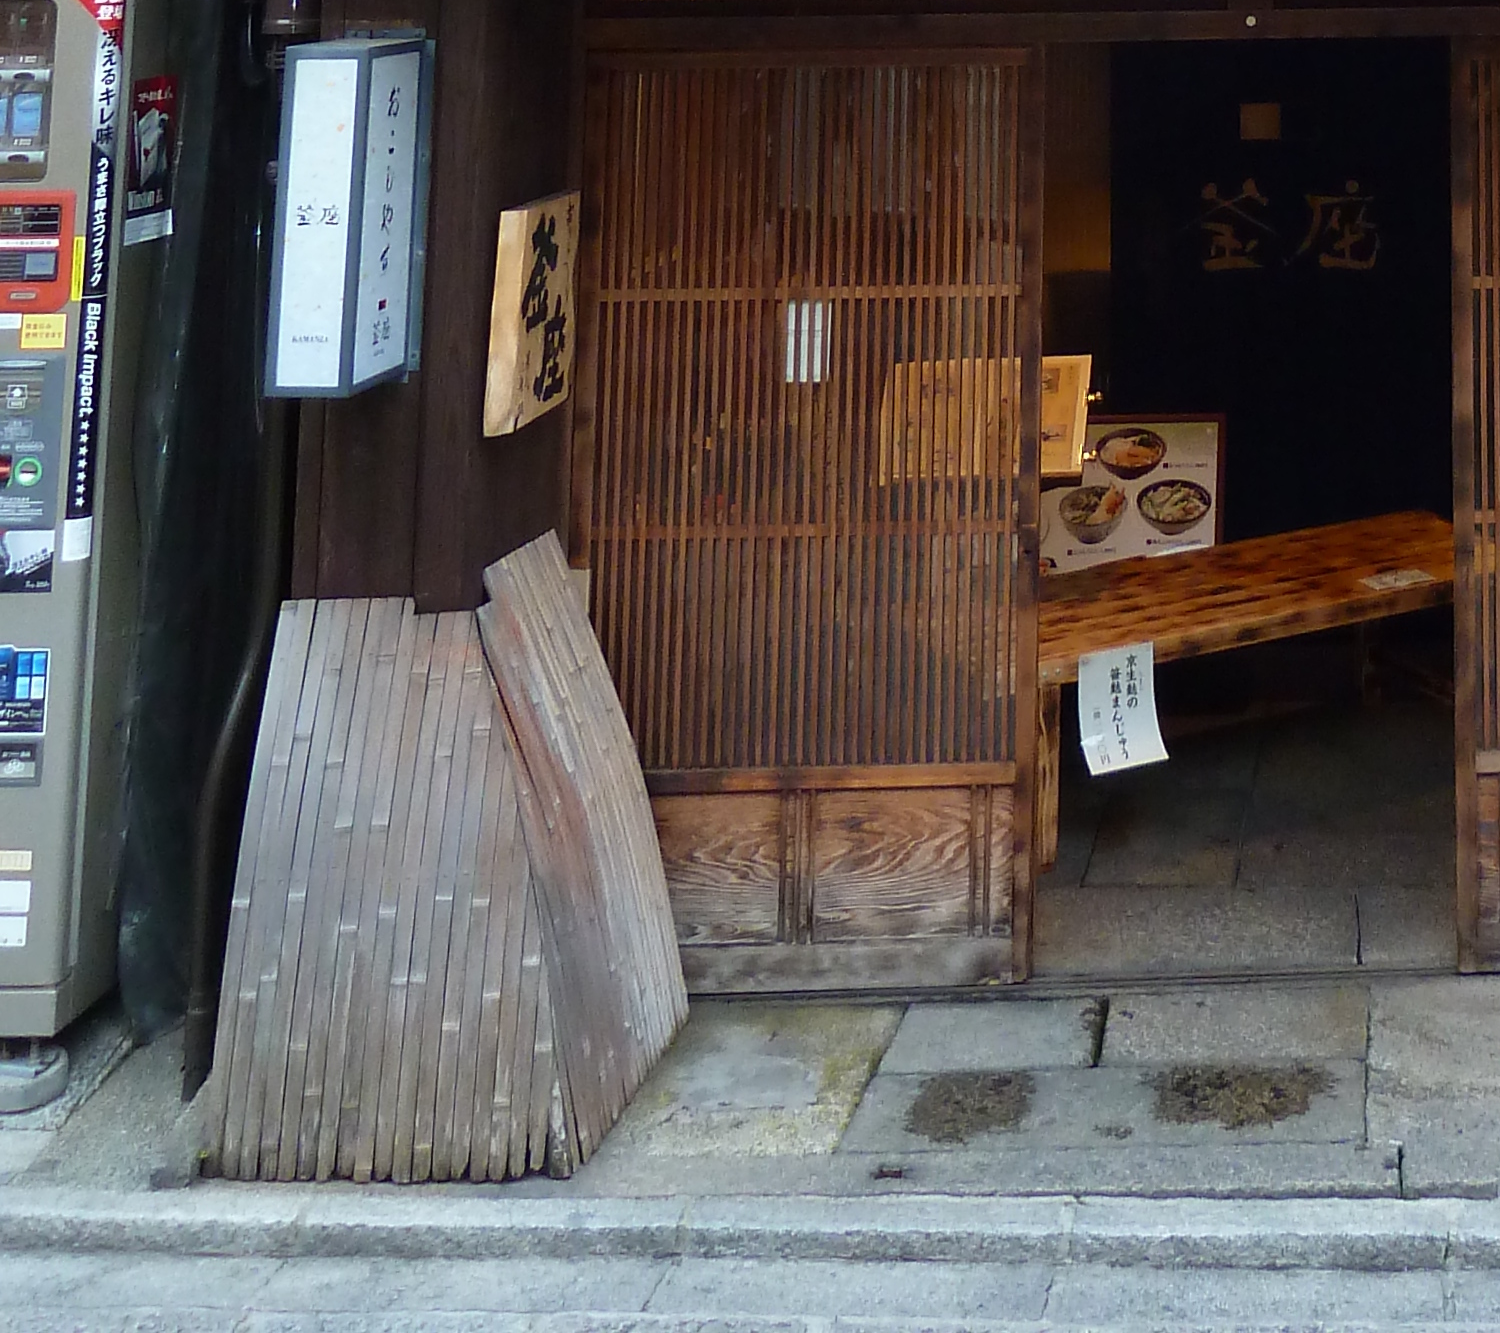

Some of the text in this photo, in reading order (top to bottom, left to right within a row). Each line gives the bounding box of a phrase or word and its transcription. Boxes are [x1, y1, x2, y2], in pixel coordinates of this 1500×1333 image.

[96, 4, 123, 20] 登場
[95, 29, 119, 144] 冴えるキレ味
[296, 203, 341, 226] 釜座
[1180, 178, 1380, 270] 釜座
[521, 212, 567, 403] 釜座
[78, 302, 102, 418] Black Impact
